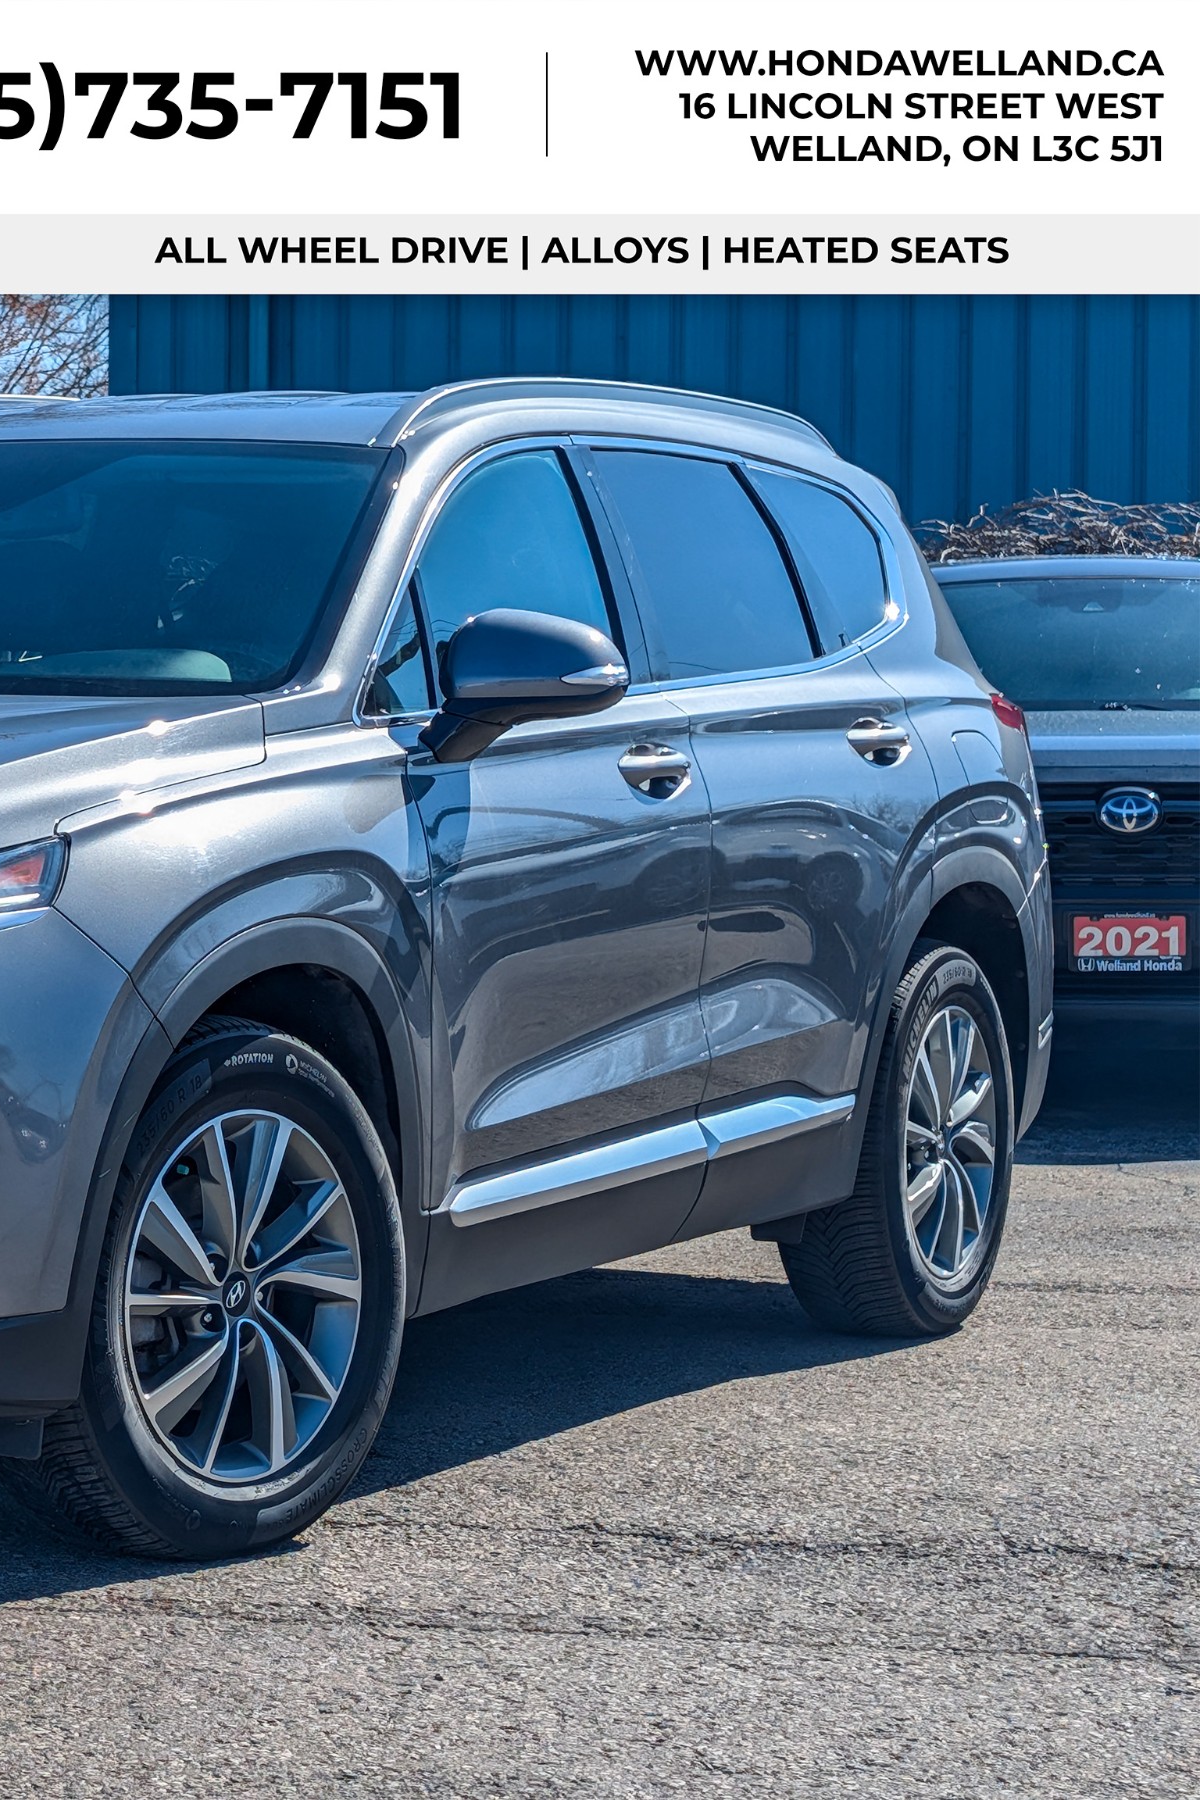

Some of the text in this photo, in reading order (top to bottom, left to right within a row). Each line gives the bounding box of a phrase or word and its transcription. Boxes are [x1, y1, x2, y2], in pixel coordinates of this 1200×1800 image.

[1078, 926, 1179, 956] 2021
[1096, 958, 1182, 972] Welland Honda
[903, 980, 937, 1079] MICHELIN
[231, 1053, 274, 1067] ROTATION
